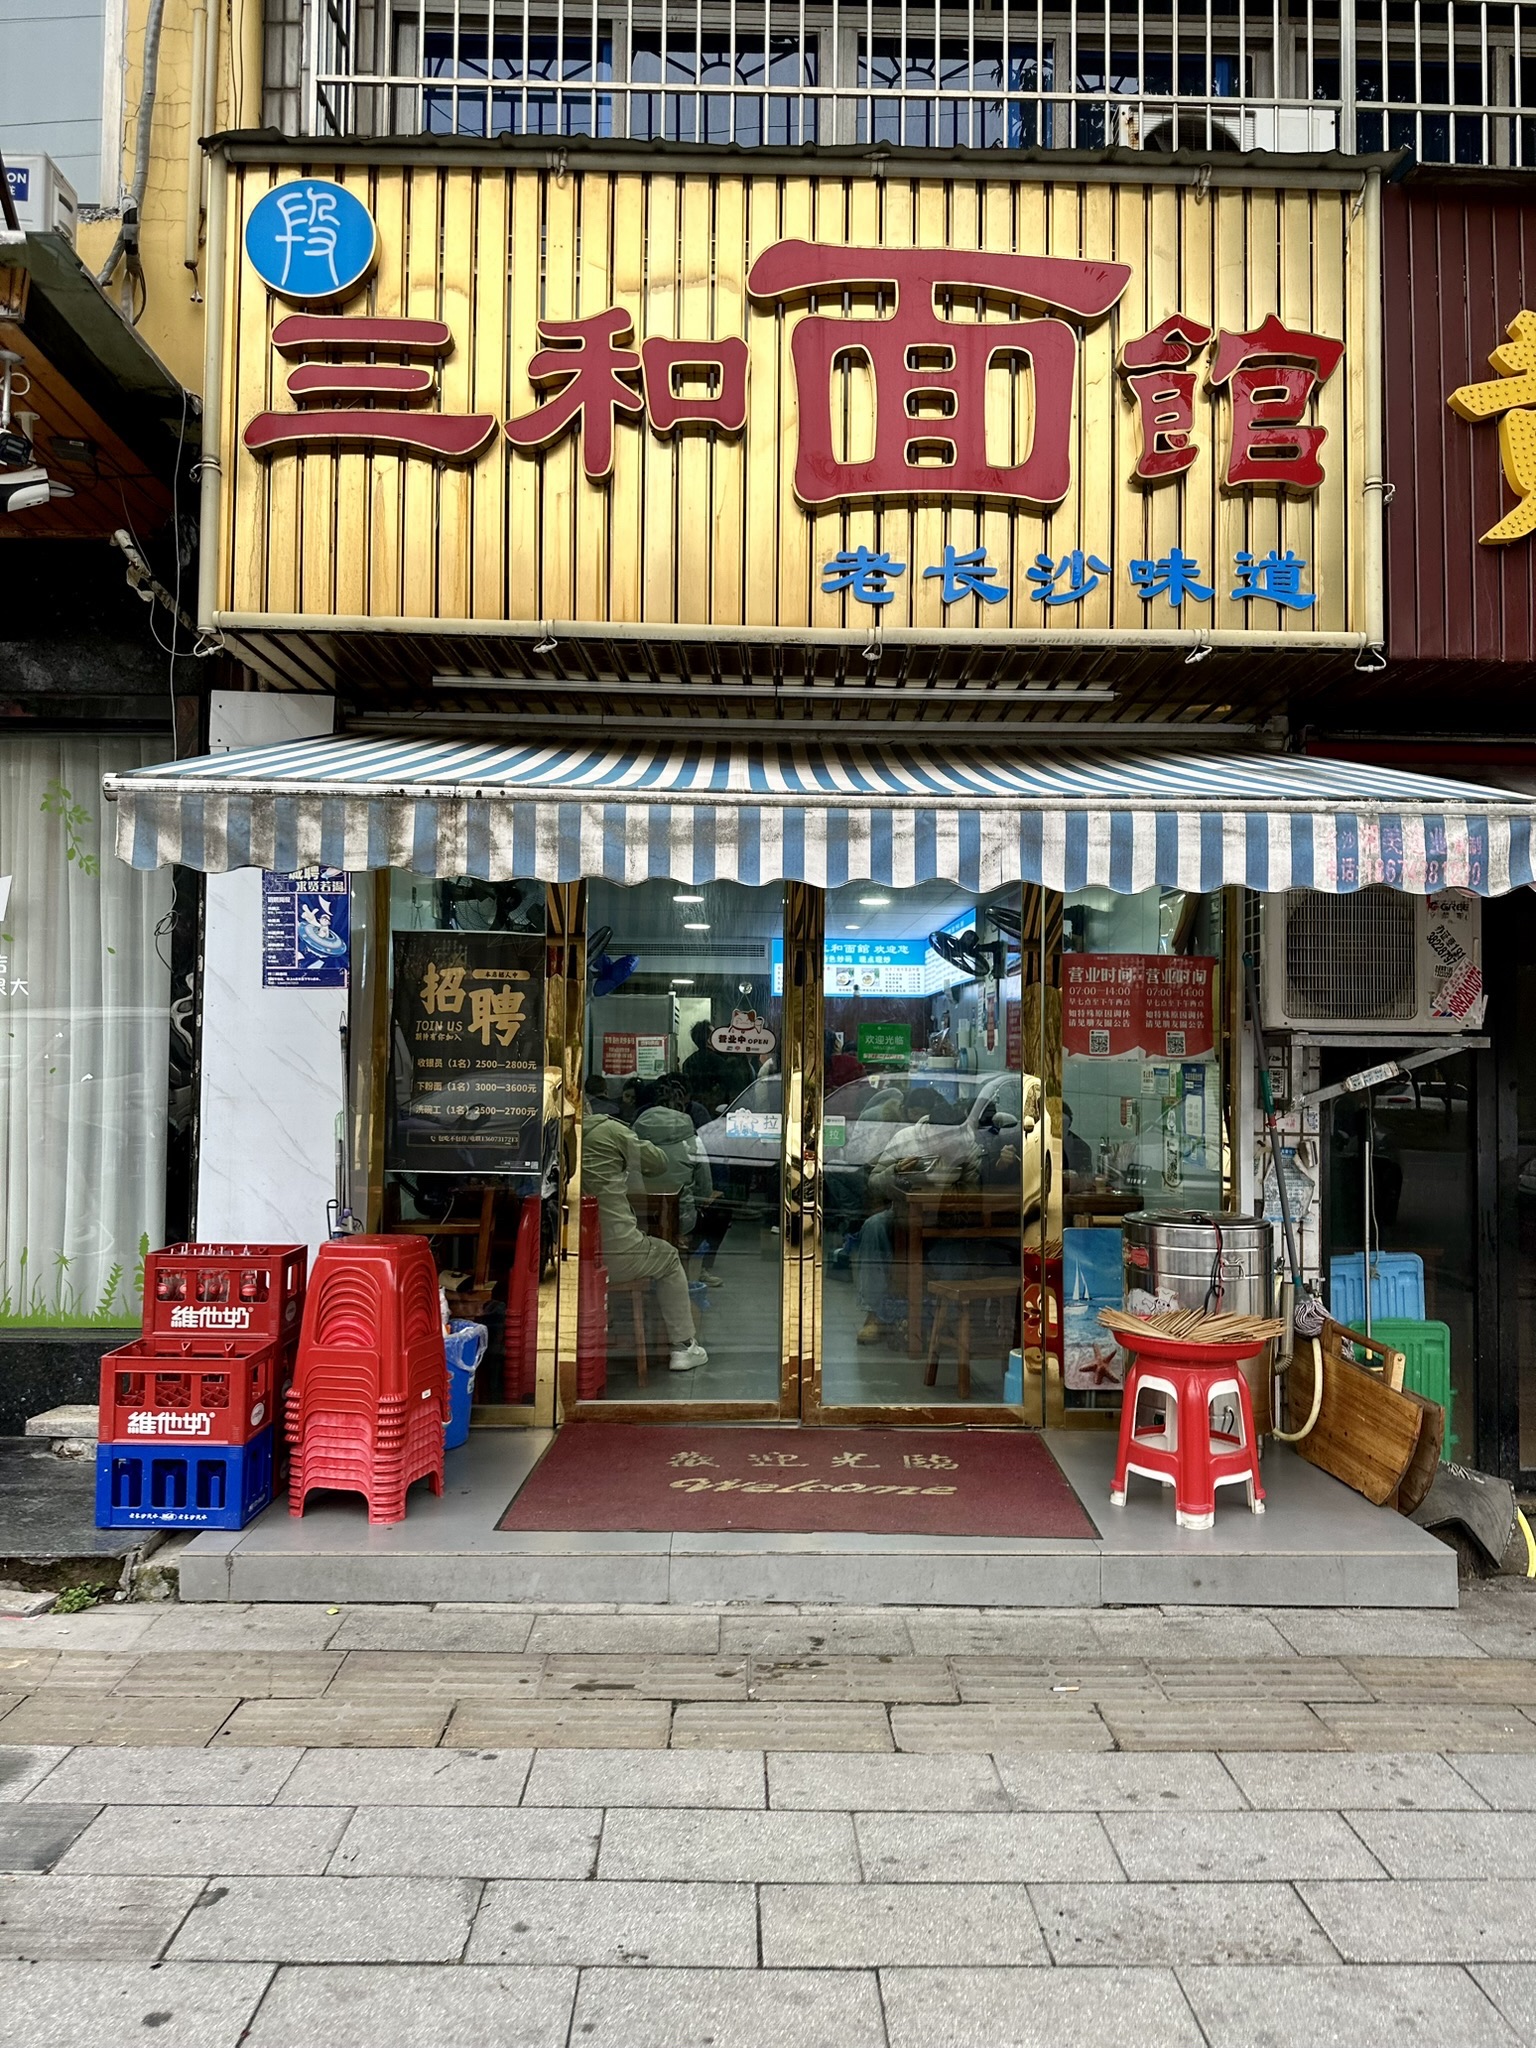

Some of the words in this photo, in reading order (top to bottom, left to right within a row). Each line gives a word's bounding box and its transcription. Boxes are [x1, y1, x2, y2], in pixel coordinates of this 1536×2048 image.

[820, 544, 1318, 610] 老长沙味道
[296, 881, 344, 892] 求贤若渴
[824, 943, 870, 954] 和面館
[1068, 967, 1133, 983] 营业时间
[1146, 968, 1207, 985] 营业时间
[1069, 998, 1131, 1006] 早七点至下午两点
[416, 1020, 443, 1032] JOIN
[447, 1020, 463, 1031] US
[719, 1035, 746, 1044] 营业中
[865, 1035, 904, 1045] 欢迎光临
[763, 1115, 779, 1130] 拉
[829, 1130, 840, 1140] 拉
[171, 1305, 250, 1329] 維他奶
[127, 1411, 211, 1436] 維他奶
[669, 1477, 959, 1495] Welcome
